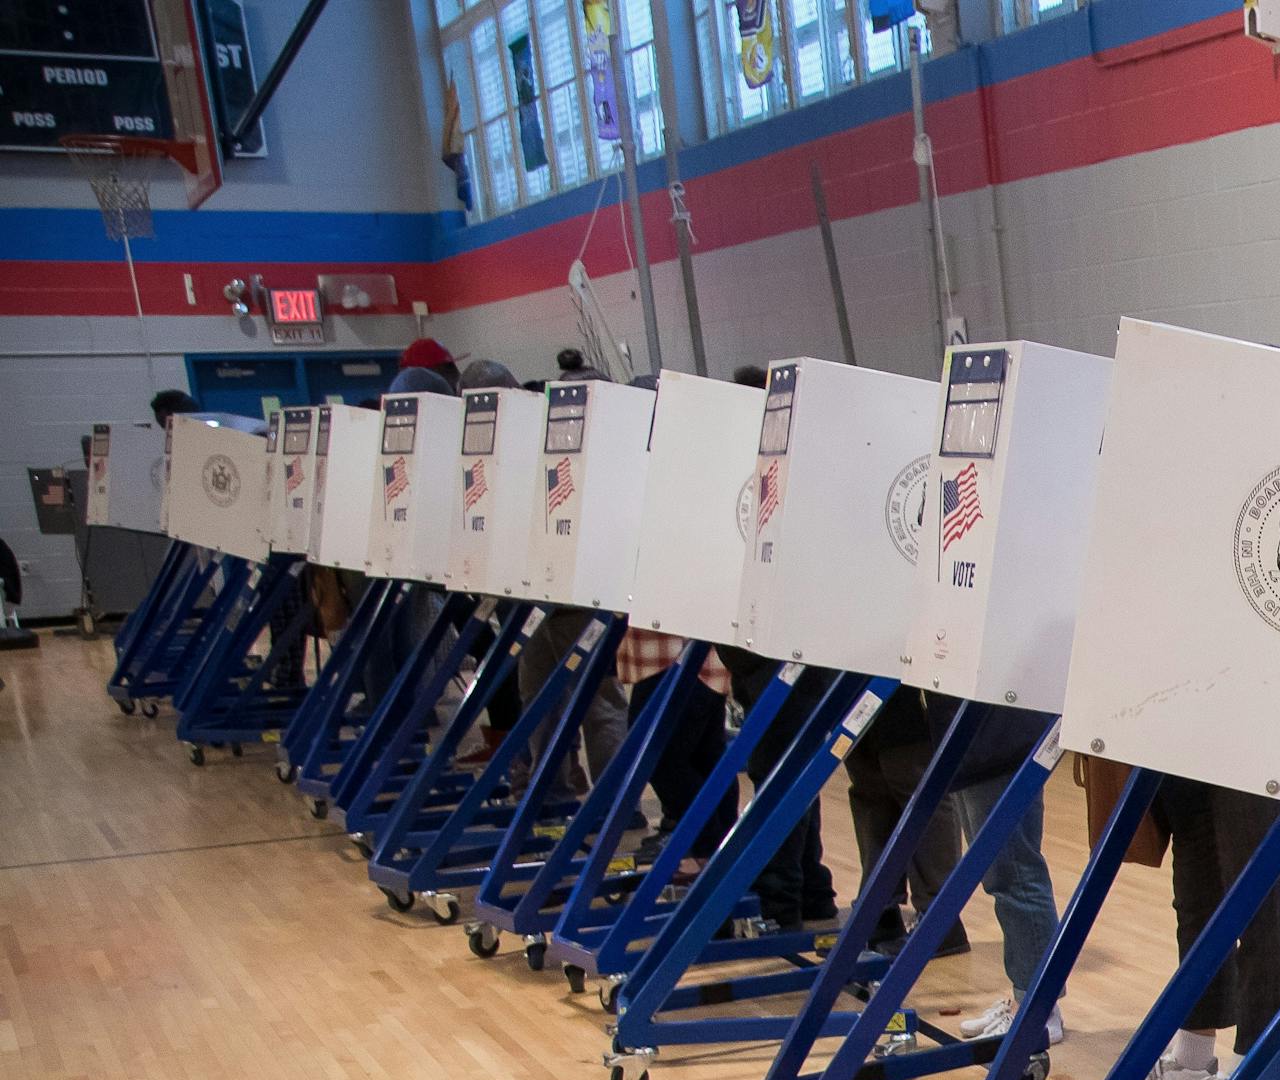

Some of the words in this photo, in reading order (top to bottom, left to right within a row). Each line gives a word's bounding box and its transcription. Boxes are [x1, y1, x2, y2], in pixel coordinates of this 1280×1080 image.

[44, 66, 108, 86] PERIOD
[12, 111, 56, 128] POSS
[113, 115, 155, 132] POSS
[274, 290, 317, 321] EXIT
[899, 461, 931, 488] BOAR
[471, 516, 485, 532] VOTE
[555, 519, 571, 536] VOTE
[1242, 539, 1253, 558] IN
[952, 560, 976, 588] VOTE
[1244, 562, 1266, 598] THE
